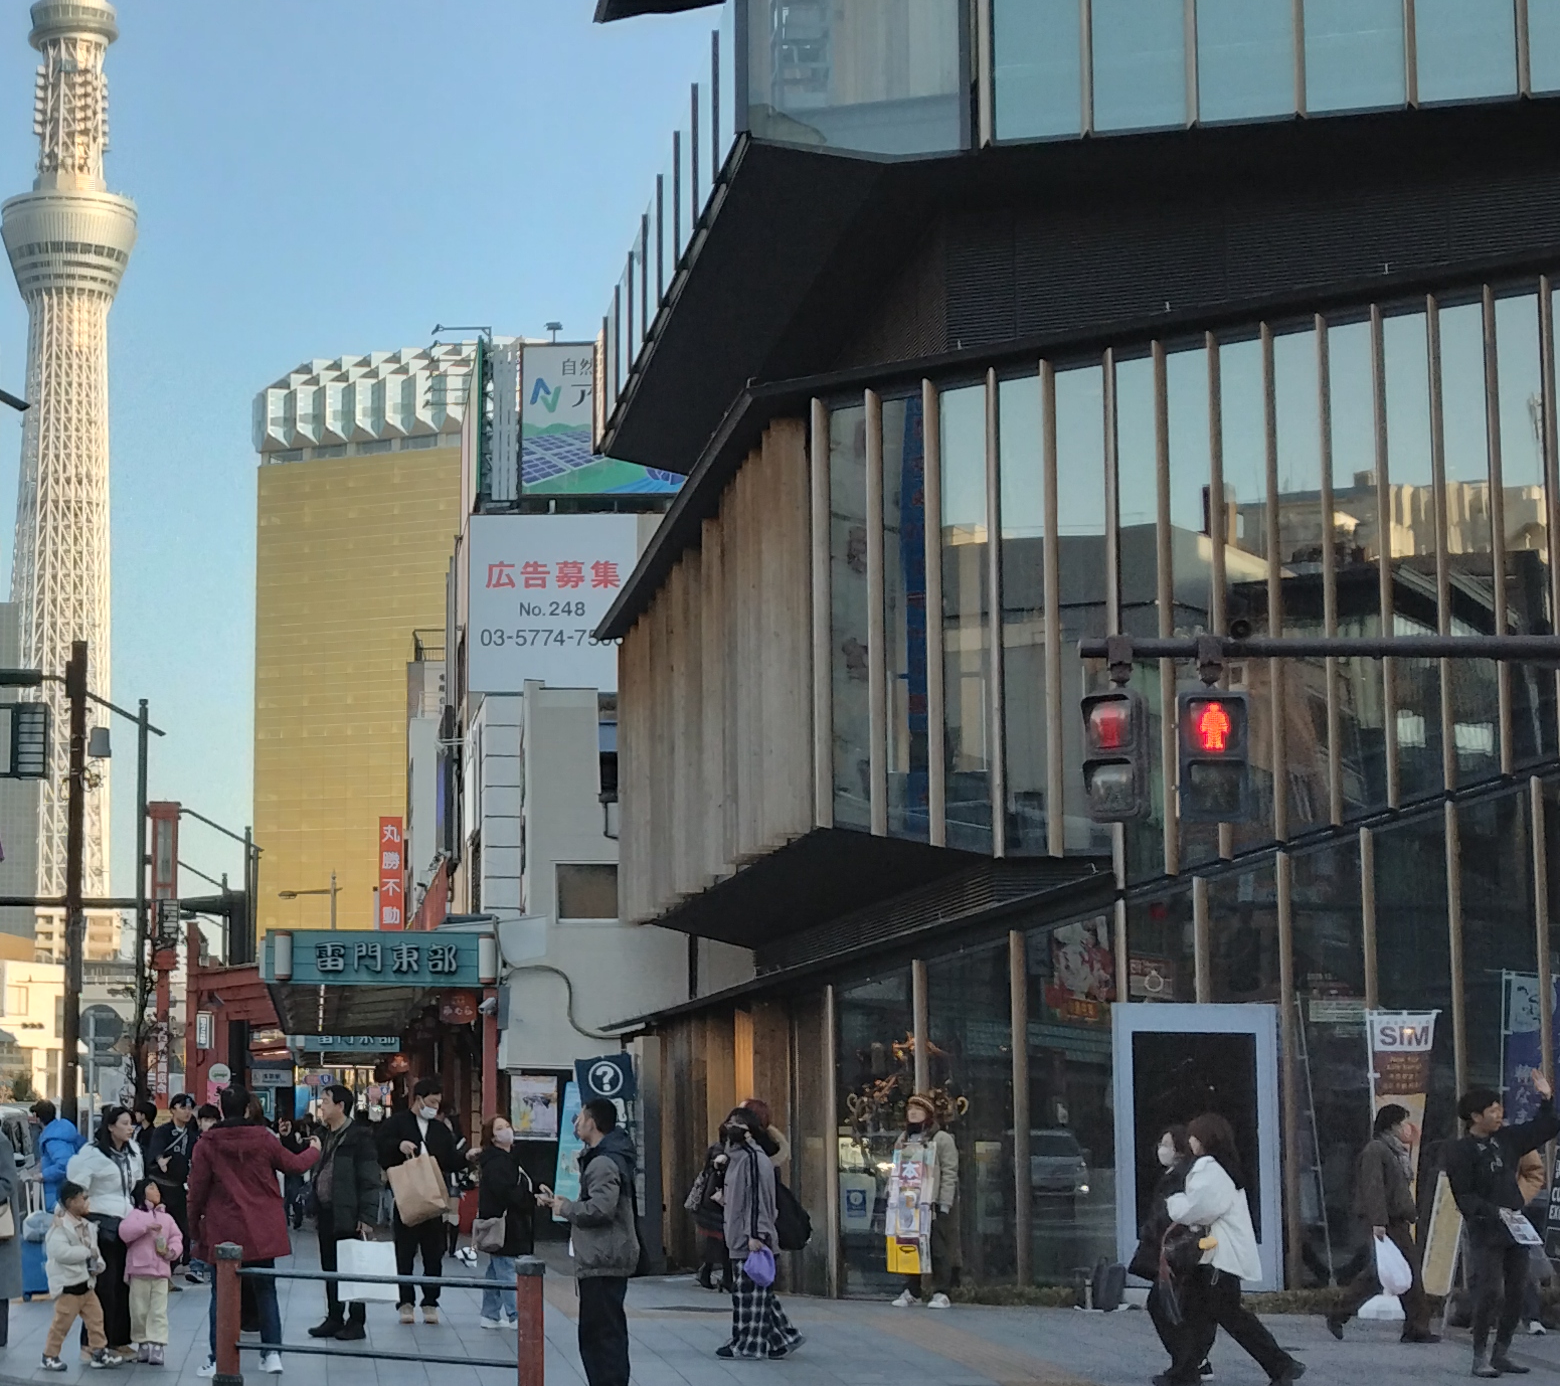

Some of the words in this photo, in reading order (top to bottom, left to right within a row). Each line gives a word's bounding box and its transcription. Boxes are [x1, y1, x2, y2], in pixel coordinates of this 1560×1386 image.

[485, 560, 621, 590] 広告募集
[382, 824, 401, 926] 丸勝不動
[315, 941, 458, 974] 雷門東部
[1379, 1025, 1430, 1047] SIM
